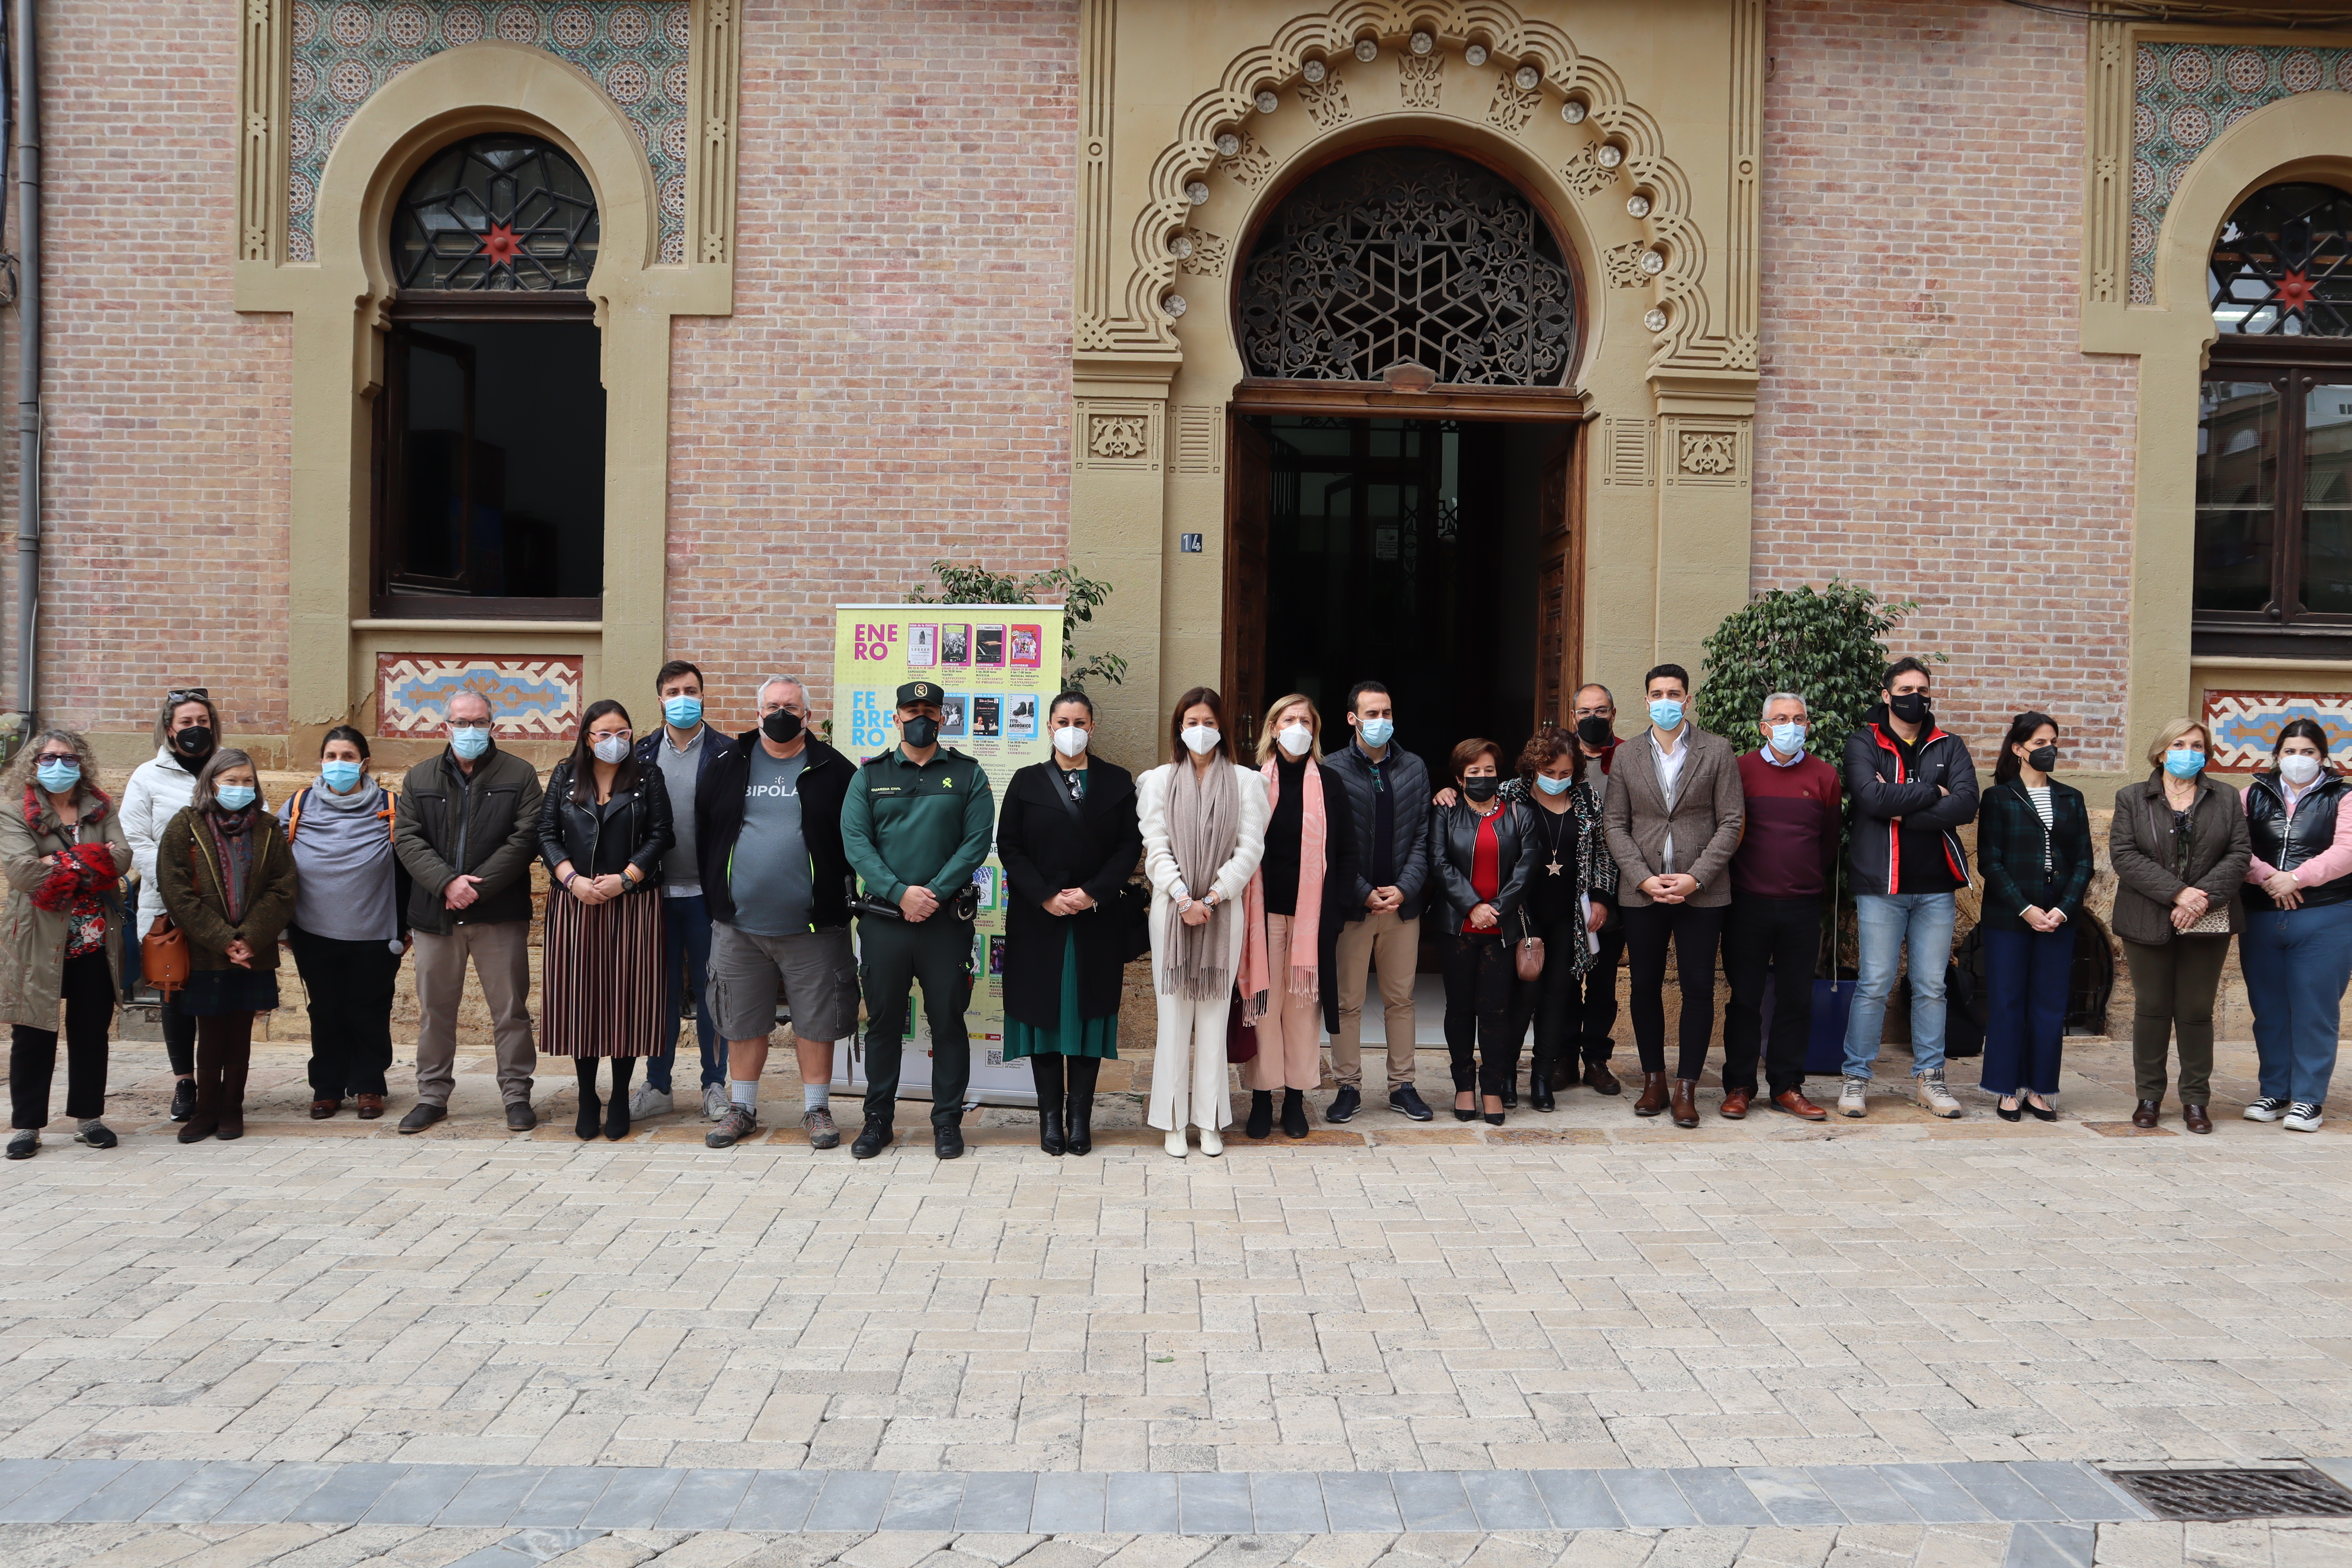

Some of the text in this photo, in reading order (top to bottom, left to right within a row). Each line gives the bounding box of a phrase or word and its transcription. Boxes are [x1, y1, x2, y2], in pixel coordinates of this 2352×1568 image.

[1183, 534, 1201, 551] 14
[855, 624, 898, 642] ENE
[854, 642, 888, 661] RO
[853, 691, 876, 709] FE
[852, 710, 893, 728] BRE
[852, 728, 886, 747] RO
[745, 785, 799, 797] BIPOLA
